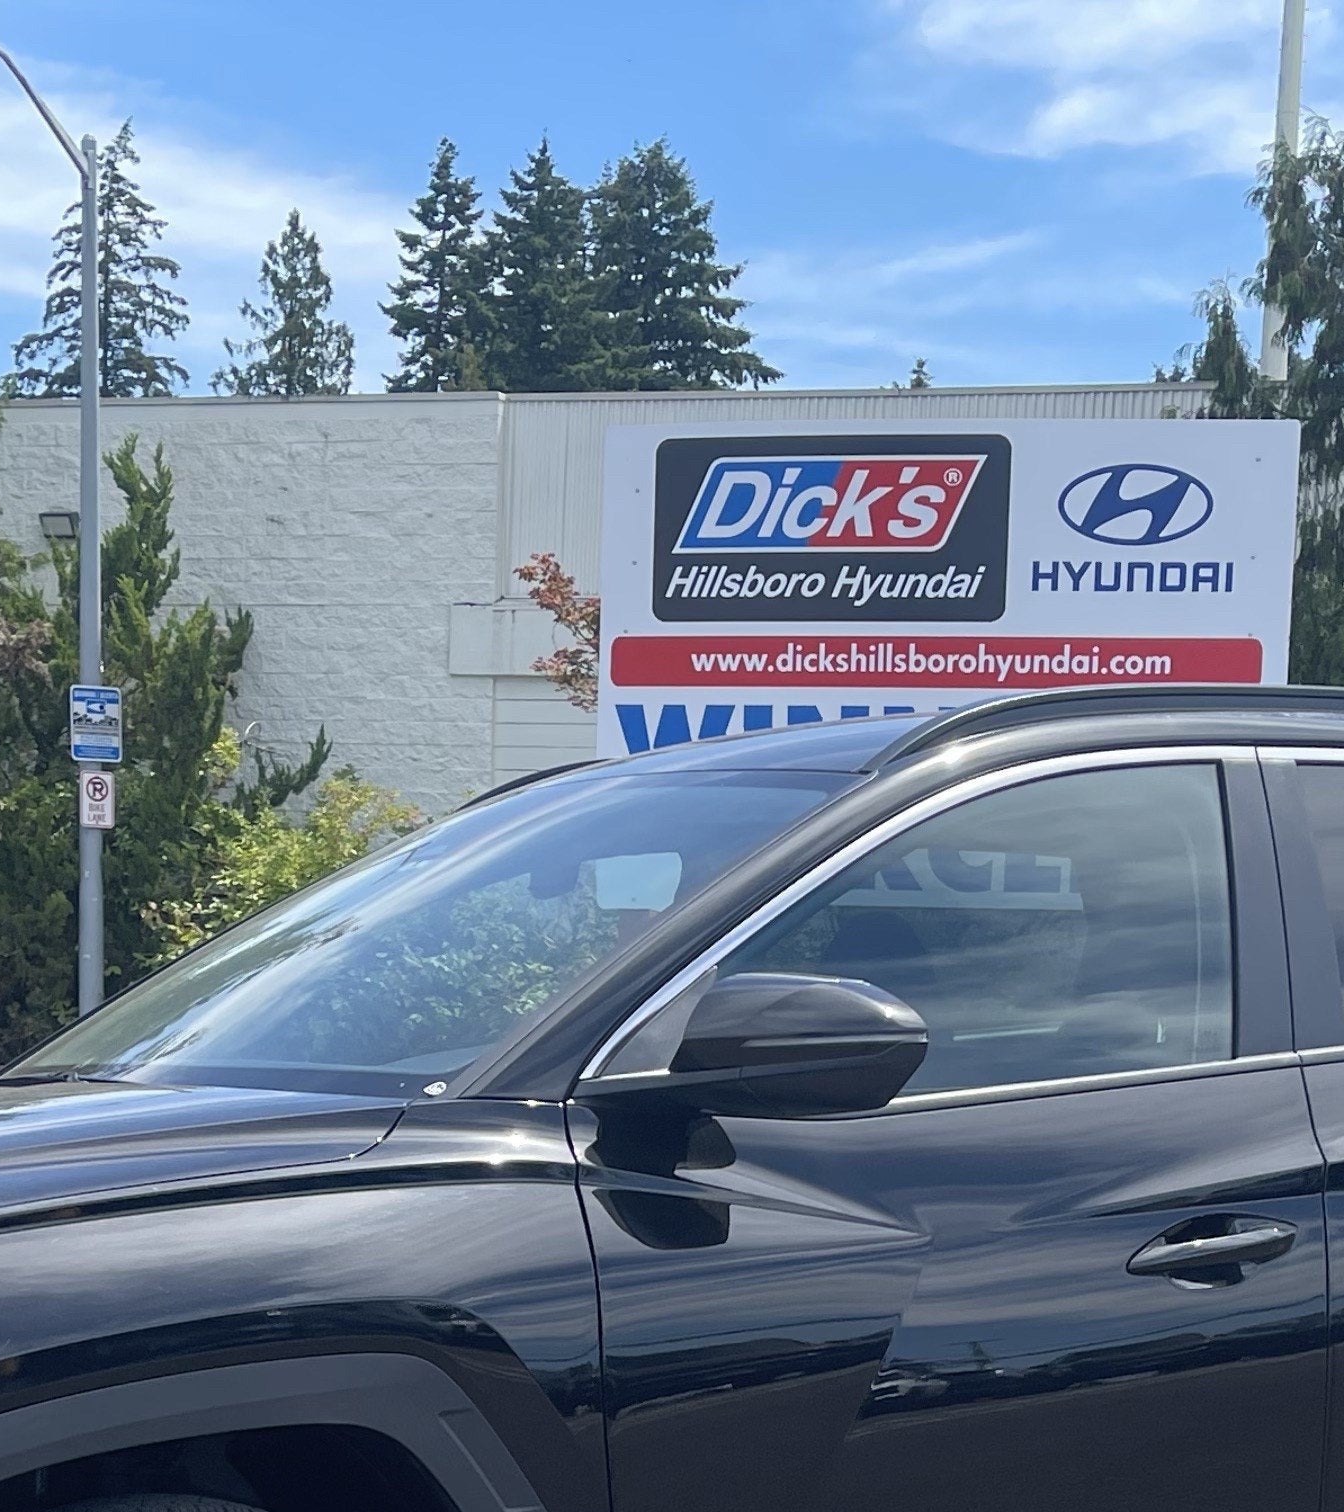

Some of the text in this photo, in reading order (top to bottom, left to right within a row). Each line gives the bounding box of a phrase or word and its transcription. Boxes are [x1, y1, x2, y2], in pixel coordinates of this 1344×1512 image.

[664, 564, 987, 607] Hillsboro Hyundai
[1030, 560, 1235, 593] HYUNDAI
[690, 643, 1173, 682] www.dickshillsborohyundai.com
